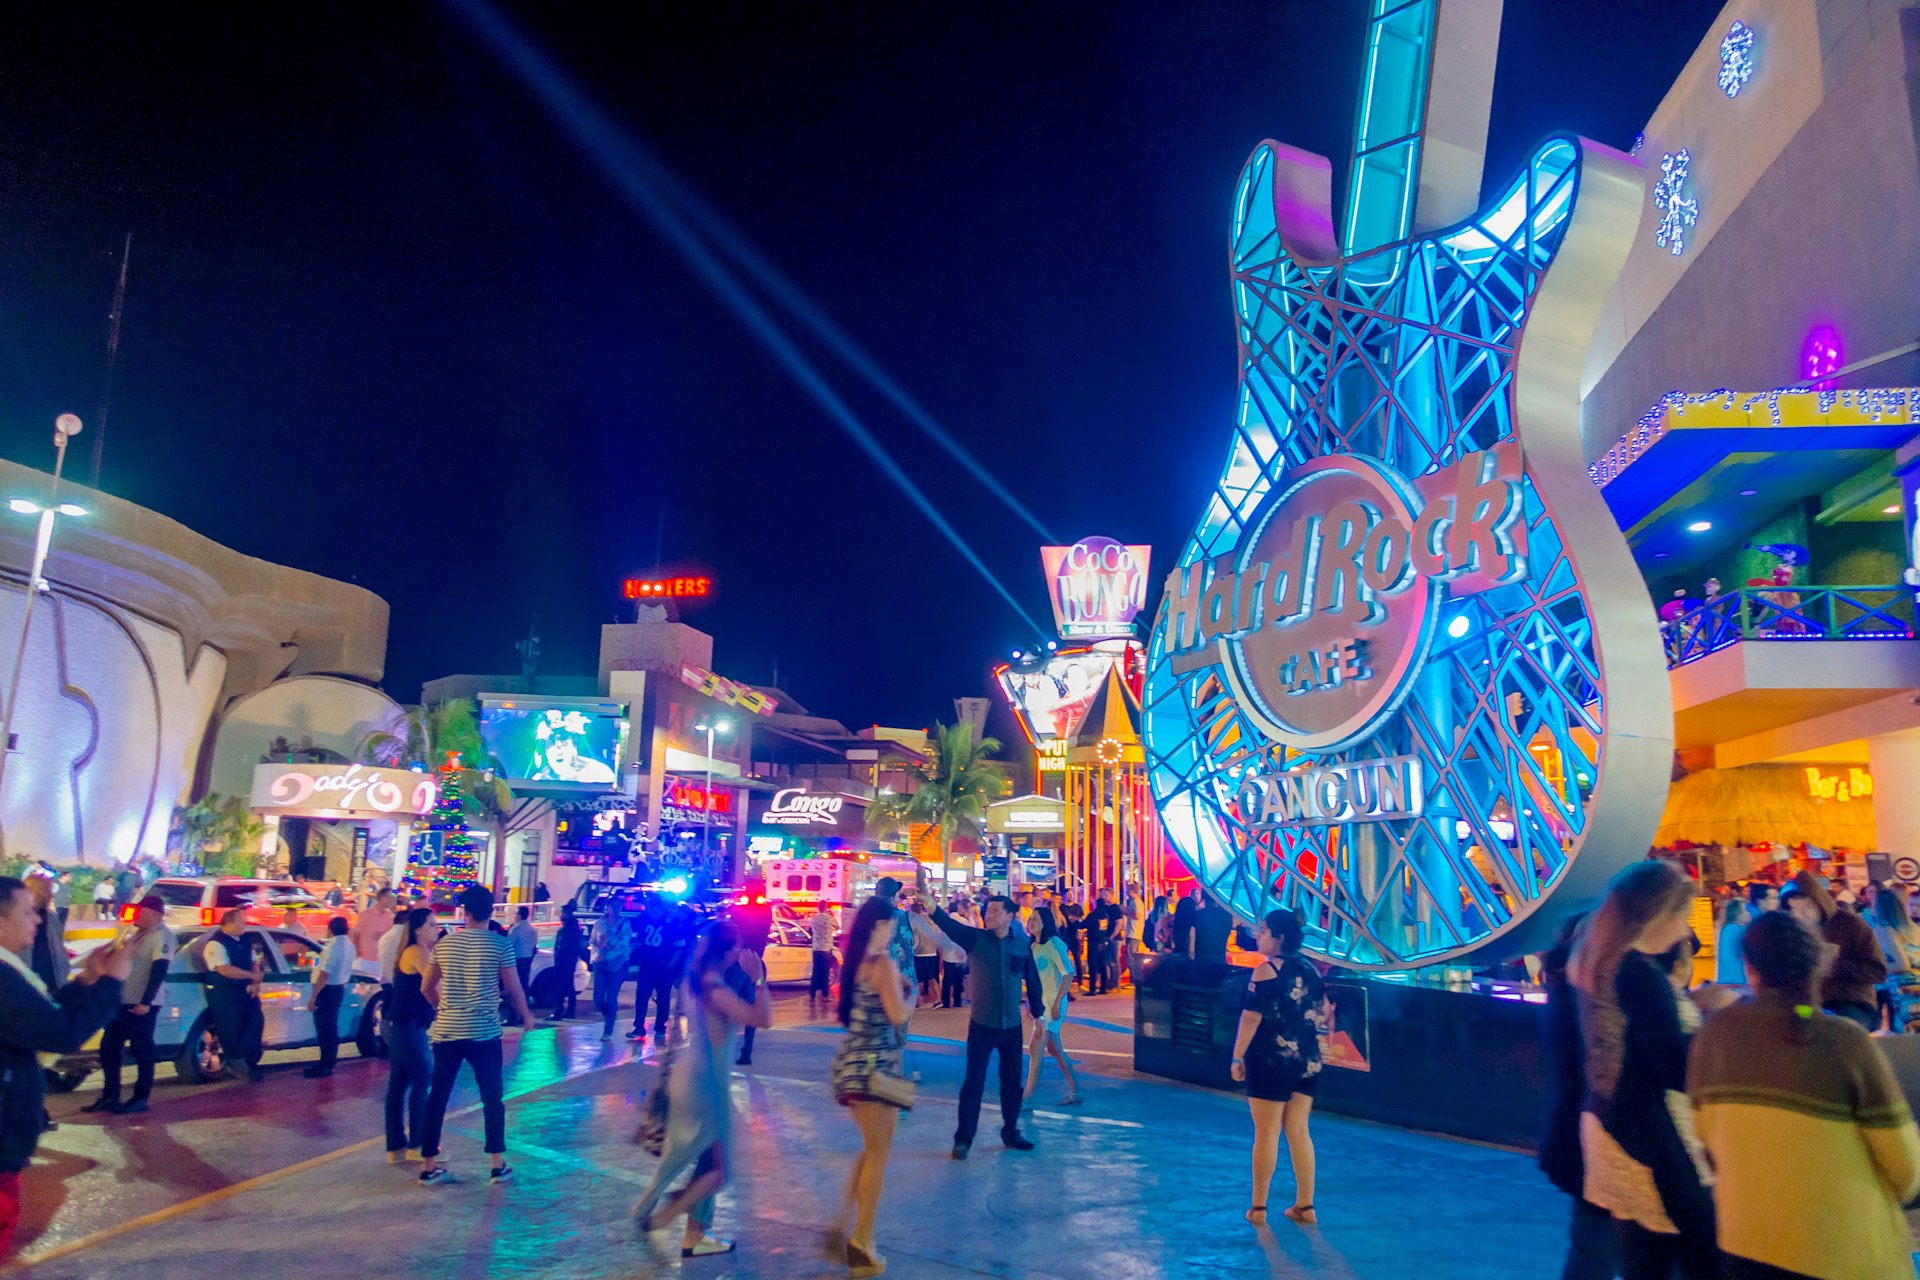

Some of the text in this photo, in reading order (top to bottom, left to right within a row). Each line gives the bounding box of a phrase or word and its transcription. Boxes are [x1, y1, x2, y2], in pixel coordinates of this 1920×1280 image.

[1067, 543, 1134, 572] CoCo
[1163, 449, 1526, 653] Hard Rock
[623, 576, 709, 598] HOOTERS
[1057, 570, 1147, 623] BONGO
[1279, 637, 1372, 696] CAFE
[771, 788, 843, 824] Congo
[1238, 762, 1415, 825] CANCUN
[645, 925, 663, 947] 26
